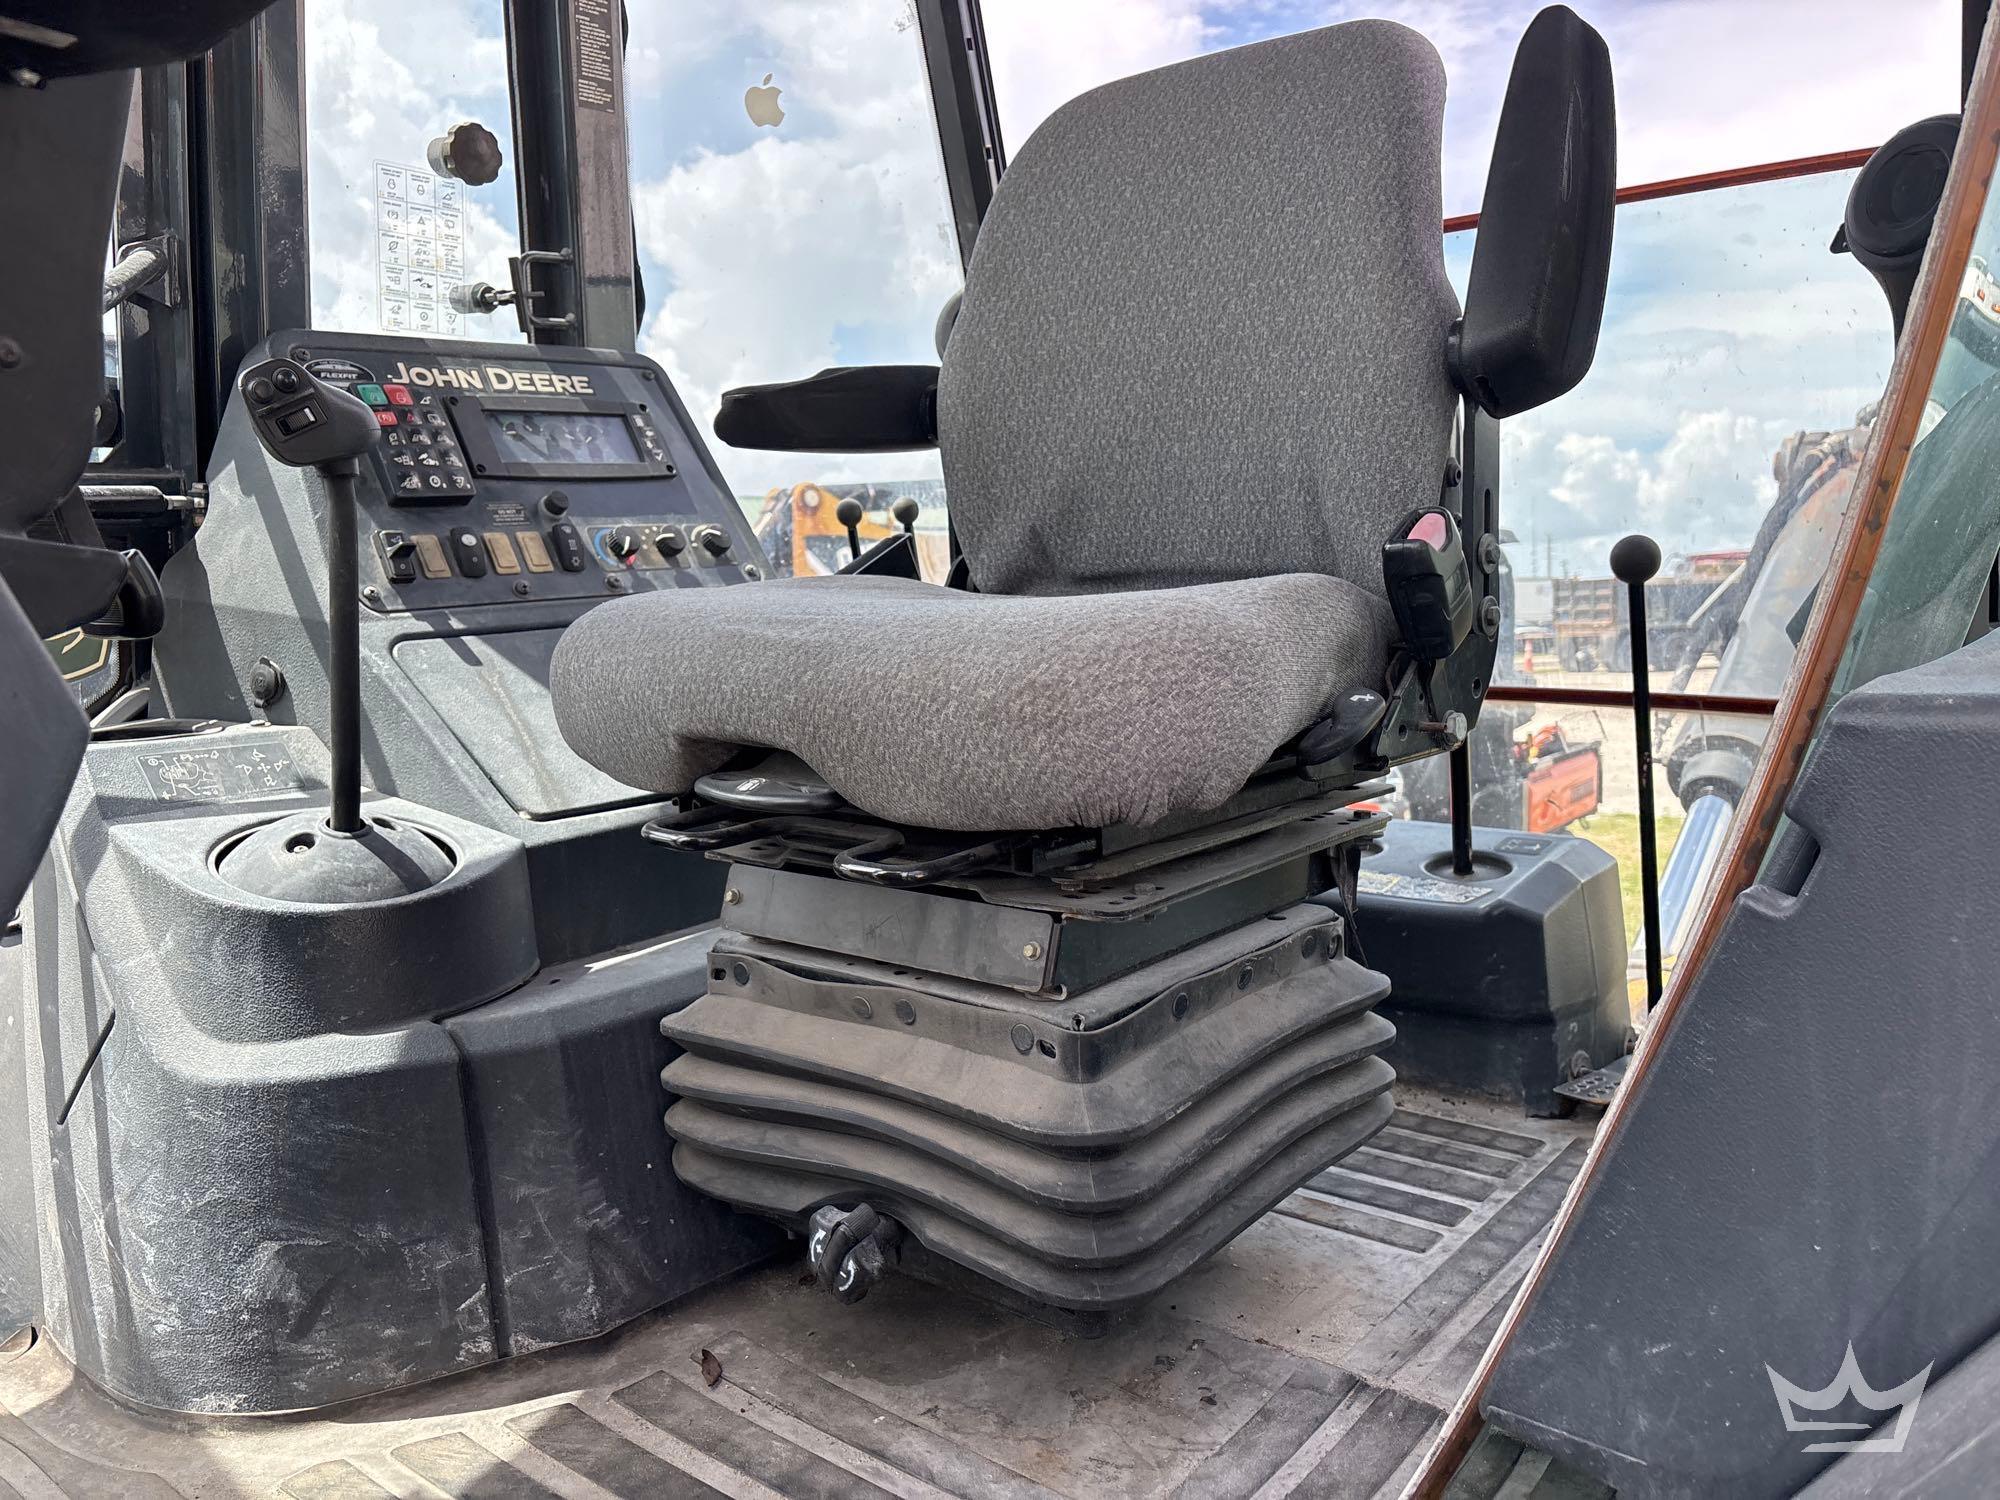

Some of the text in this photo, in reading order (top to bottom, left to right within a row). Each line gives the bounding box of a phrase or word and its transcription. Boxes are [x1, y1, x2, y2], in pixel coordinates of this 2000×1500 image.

[320, 372, 359, 380] FLEXFIT
[387, 362, 594, 394] JOHN DEERE
